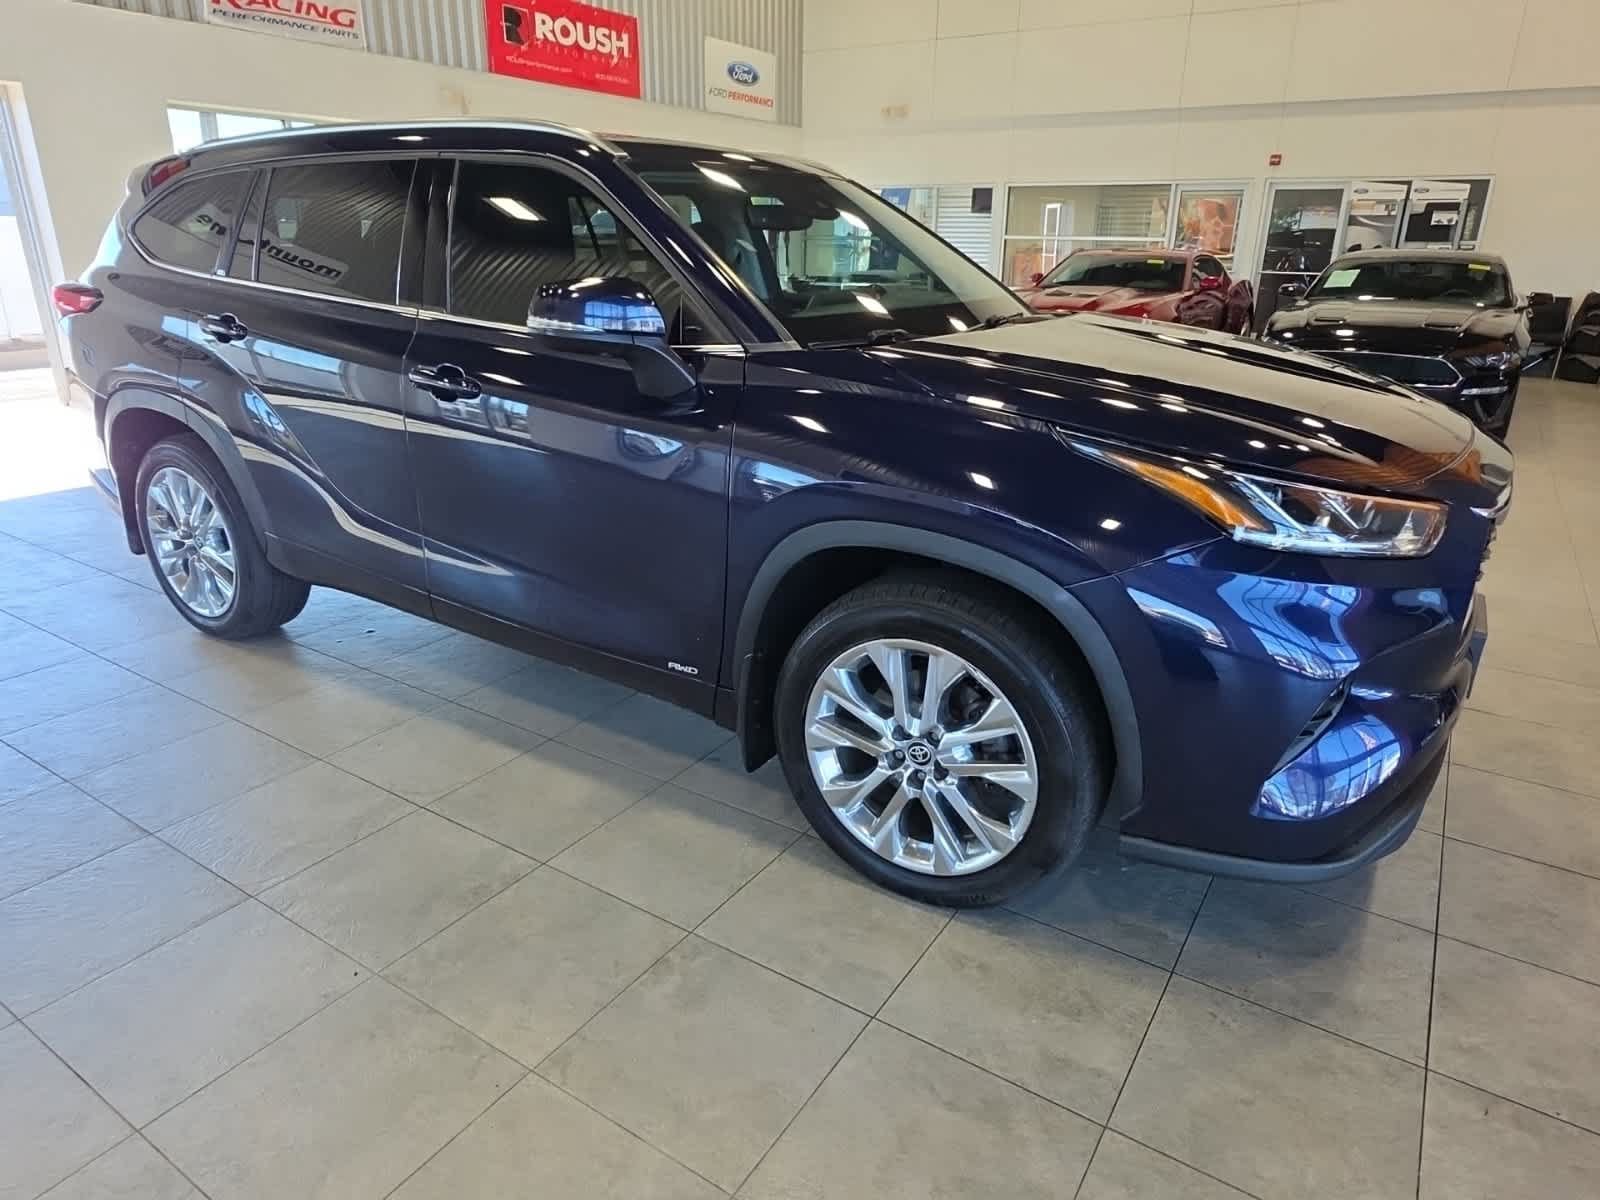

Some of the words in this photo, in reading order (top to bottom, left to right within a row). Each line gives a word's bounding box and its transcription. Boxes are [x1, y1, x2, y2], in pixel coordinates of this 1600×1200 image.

[212, 8, 319, 31] PERFORMANCE
[322, 27, 360, 40] PARTS
[534, 12, 630, 58] ROUSH
[732, 64, 754, 83] Ford
[709, 87, 728, 98] FORD
[668, 661, 699, 675] AWD
